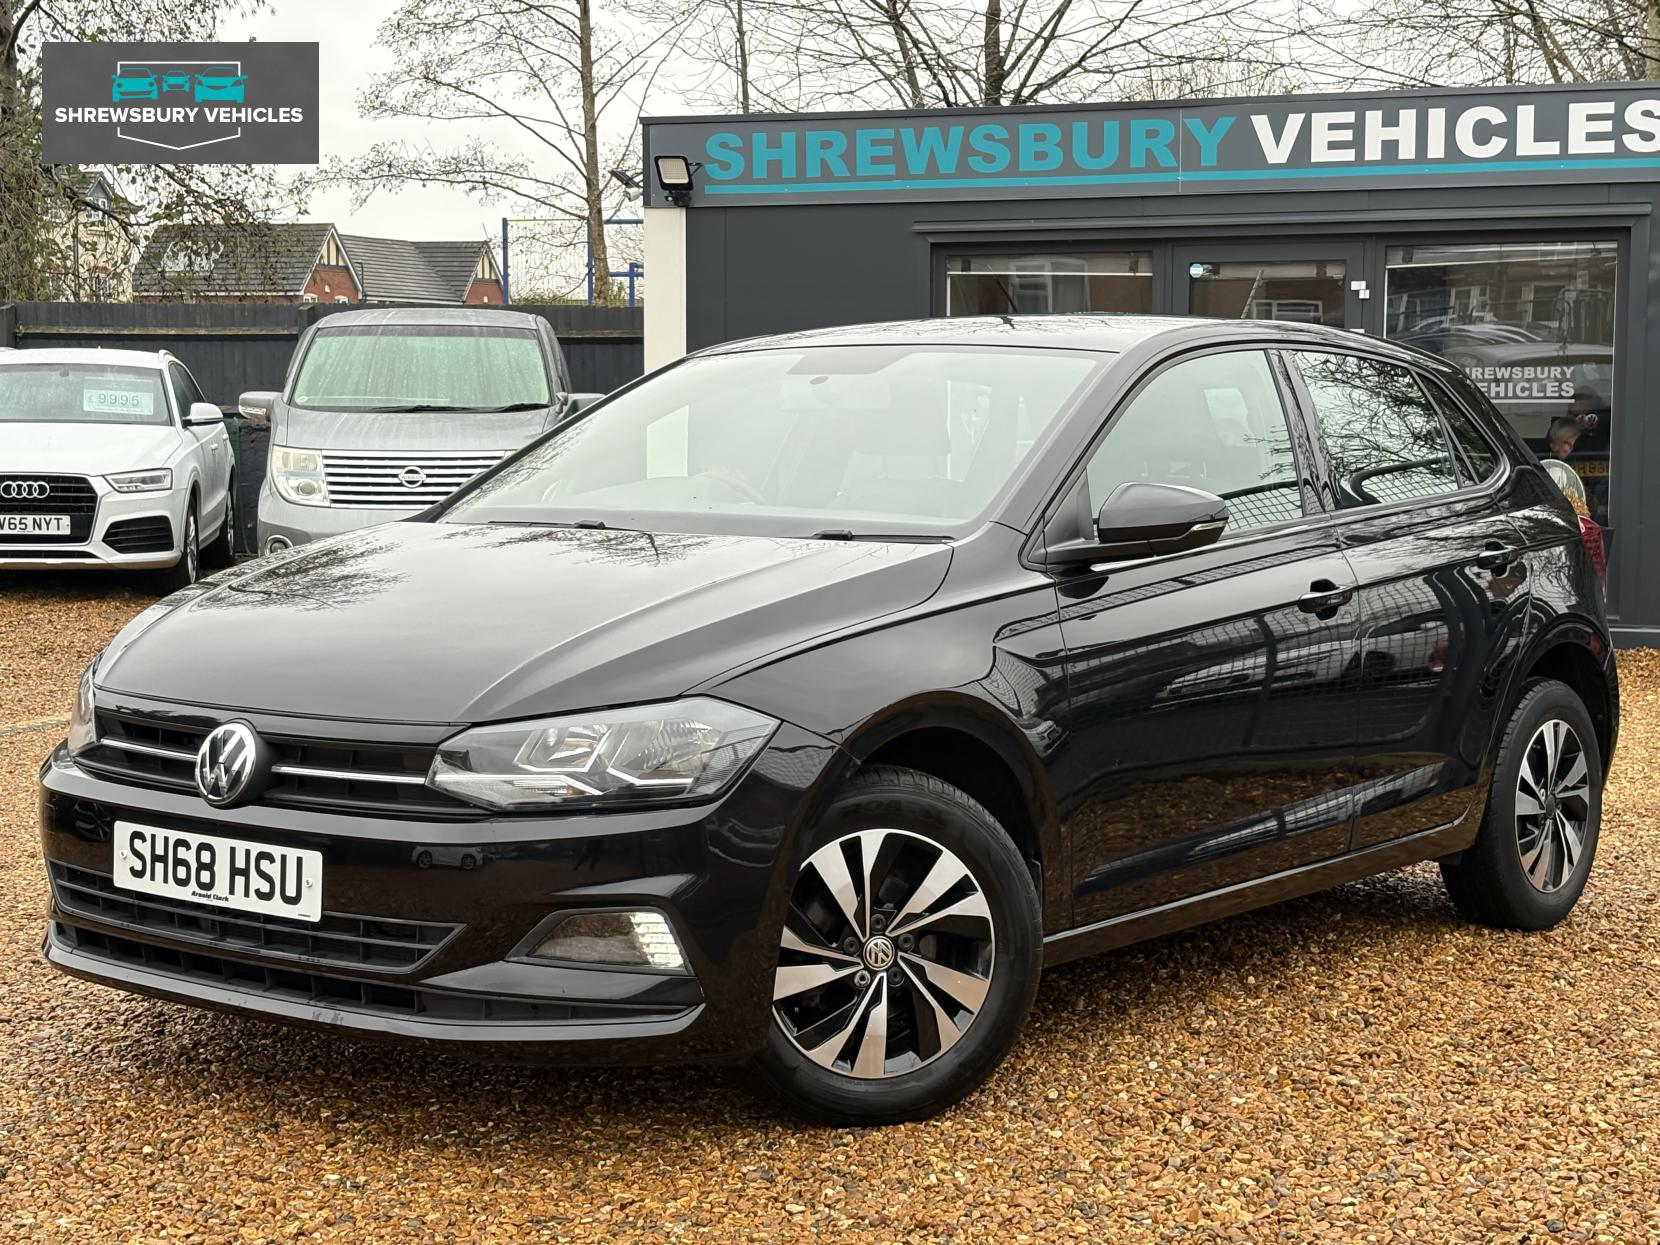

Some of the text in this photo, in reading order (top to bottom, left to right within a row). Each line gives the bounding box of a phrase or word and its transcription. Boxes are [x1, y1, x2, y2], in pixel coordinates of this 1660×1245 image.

[705, 99, 1660, 181] SHREWSBURY VEHICLES
[1465, 366, 1574, 379] REWSBURY
[32, 517, 63, 531] NYT
[129, 830, 303, 906] SH68 HSU
